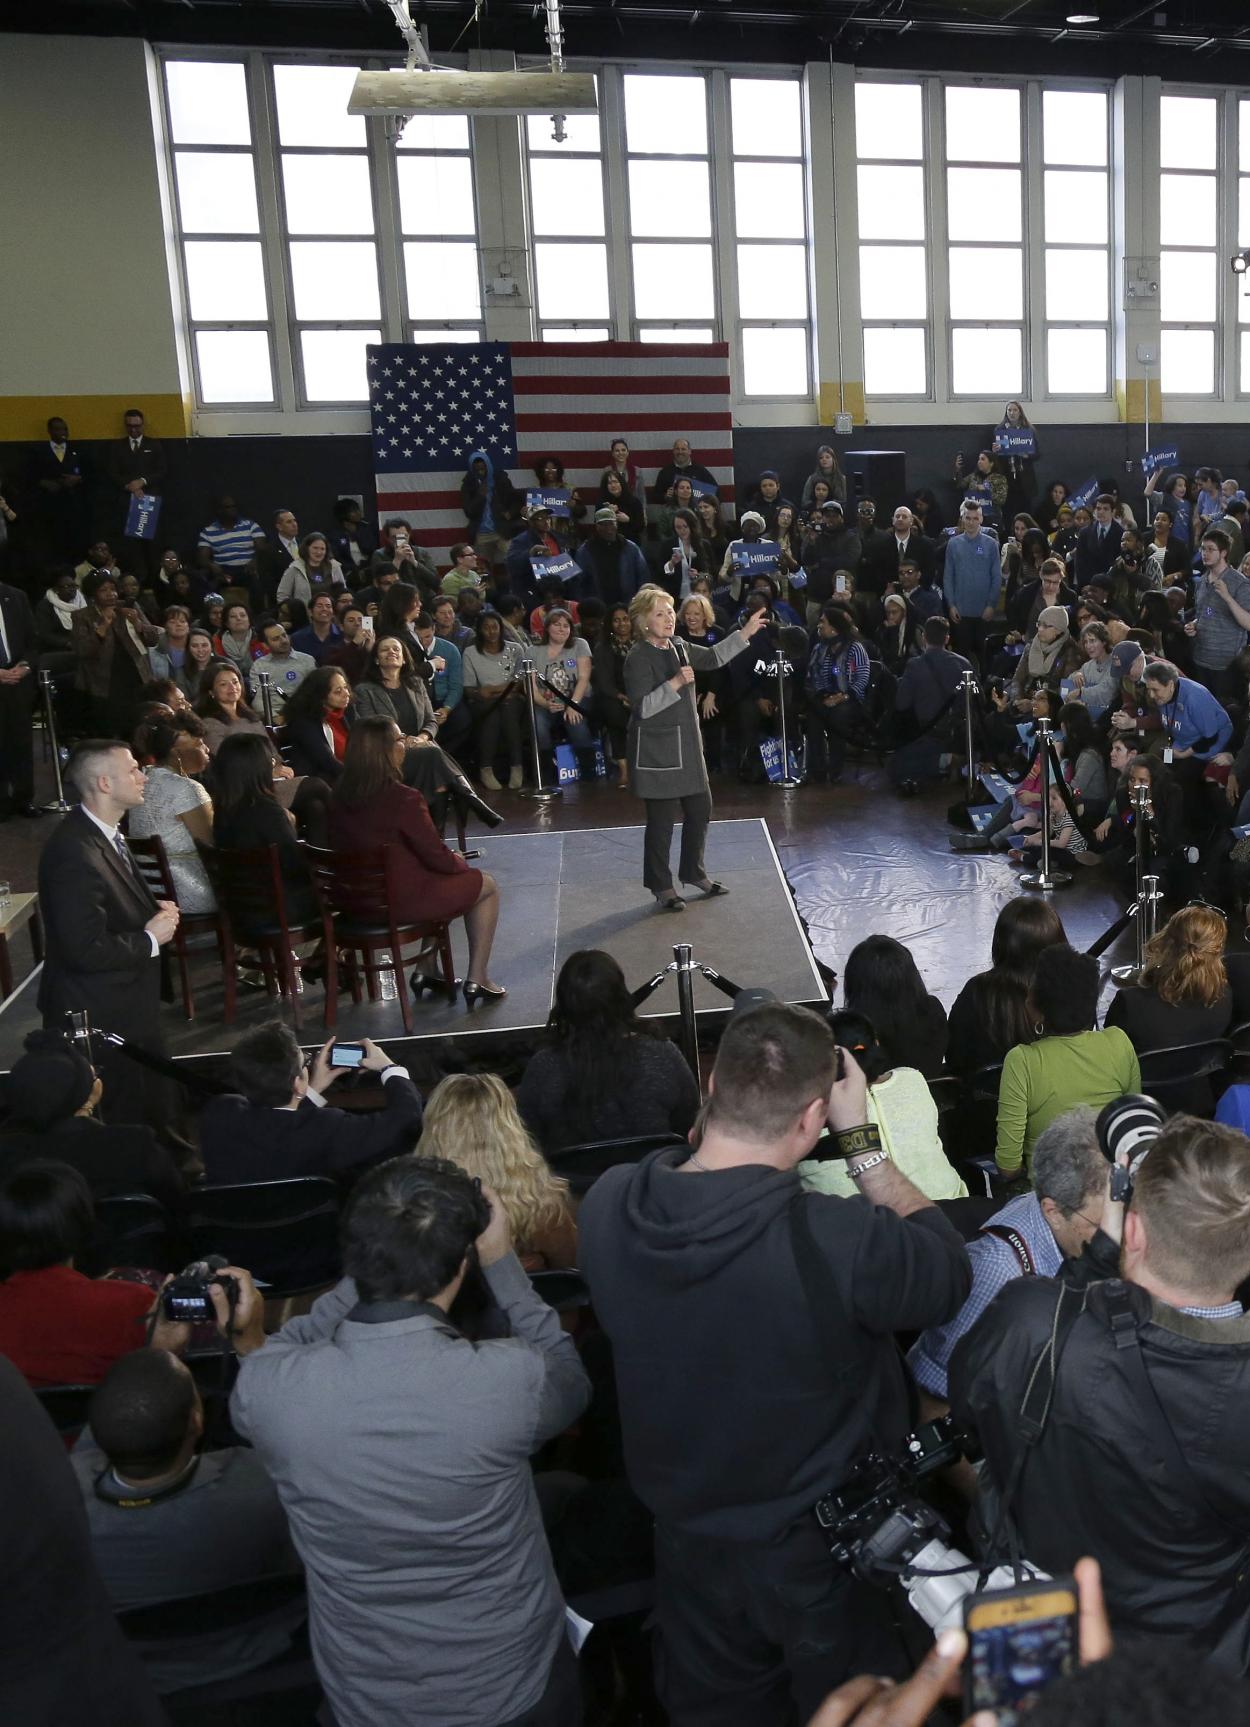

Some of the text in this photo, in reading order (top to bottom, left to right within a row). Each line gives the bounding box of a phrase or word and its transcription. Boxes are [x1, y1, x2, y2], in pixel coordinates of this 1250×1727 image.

[1009, 437, 1033, 446] Hillary
[1153, 451, 1177, 462] Hillary
[543, 497, 567, 506] Hillar
[134, 511, 149, 537] Hillary
[546, 559, 575, 575] Hillary
[1008, 1233, 1031, 1272] Canon
